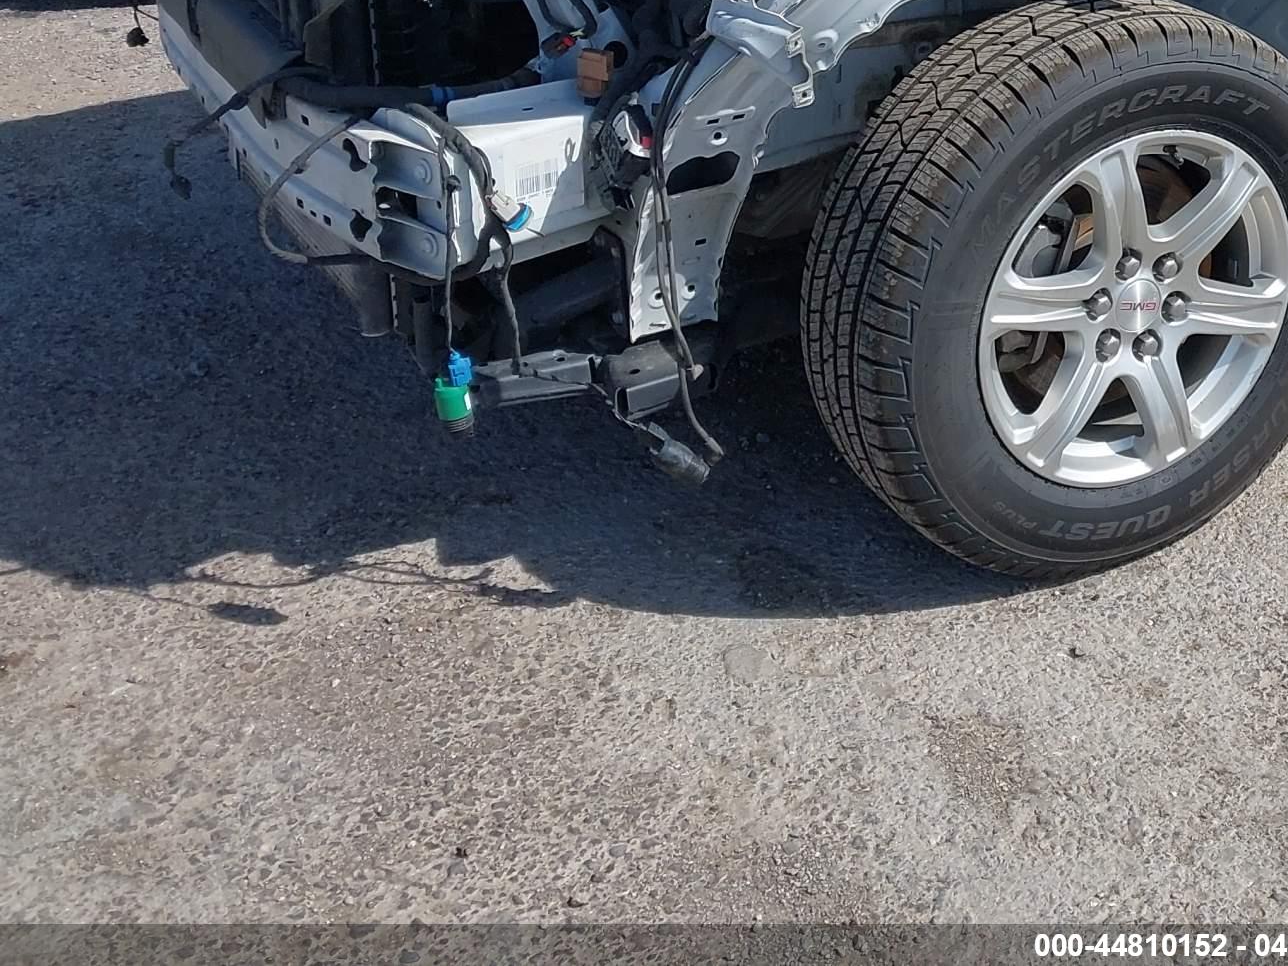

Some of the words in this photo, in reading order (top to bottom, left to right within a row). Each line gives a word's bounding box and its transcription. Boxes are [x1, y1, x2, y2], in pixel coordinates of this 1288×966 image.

[1119, 301, 1157, 311] GMC
[991, 501, 1039, 531] PLUS
[1040, 507, 1174, 541] QUEST
